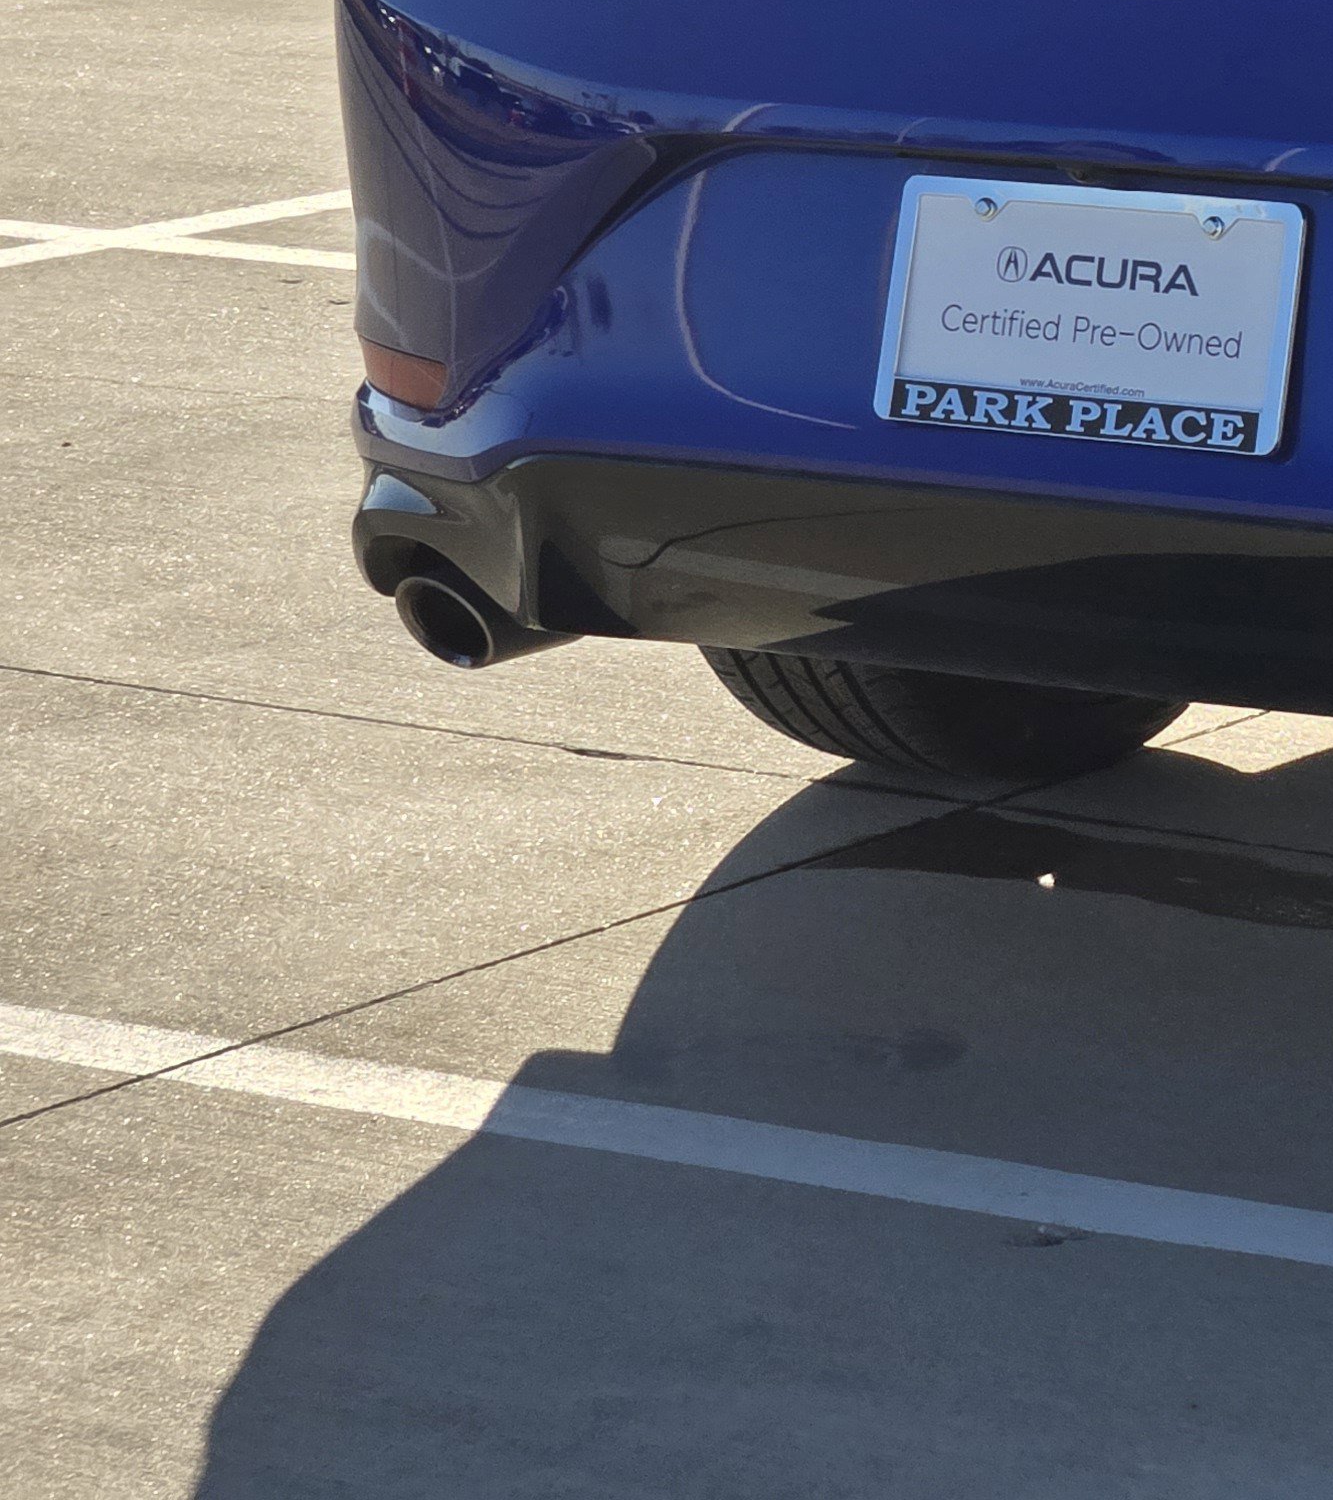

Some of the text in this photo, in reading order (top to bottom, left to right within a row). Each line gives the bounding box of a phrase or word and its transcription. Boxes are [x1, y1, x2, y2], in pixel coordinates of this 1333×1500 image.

[1029, 252, 1199, 296] ACURA
[941, 304, 1242, 359] Certified Pre-Owned
[1020, 377, 1145, 398] www.AcuraCertified.com
[901, 384, 1245, 447] PARK PLACE
